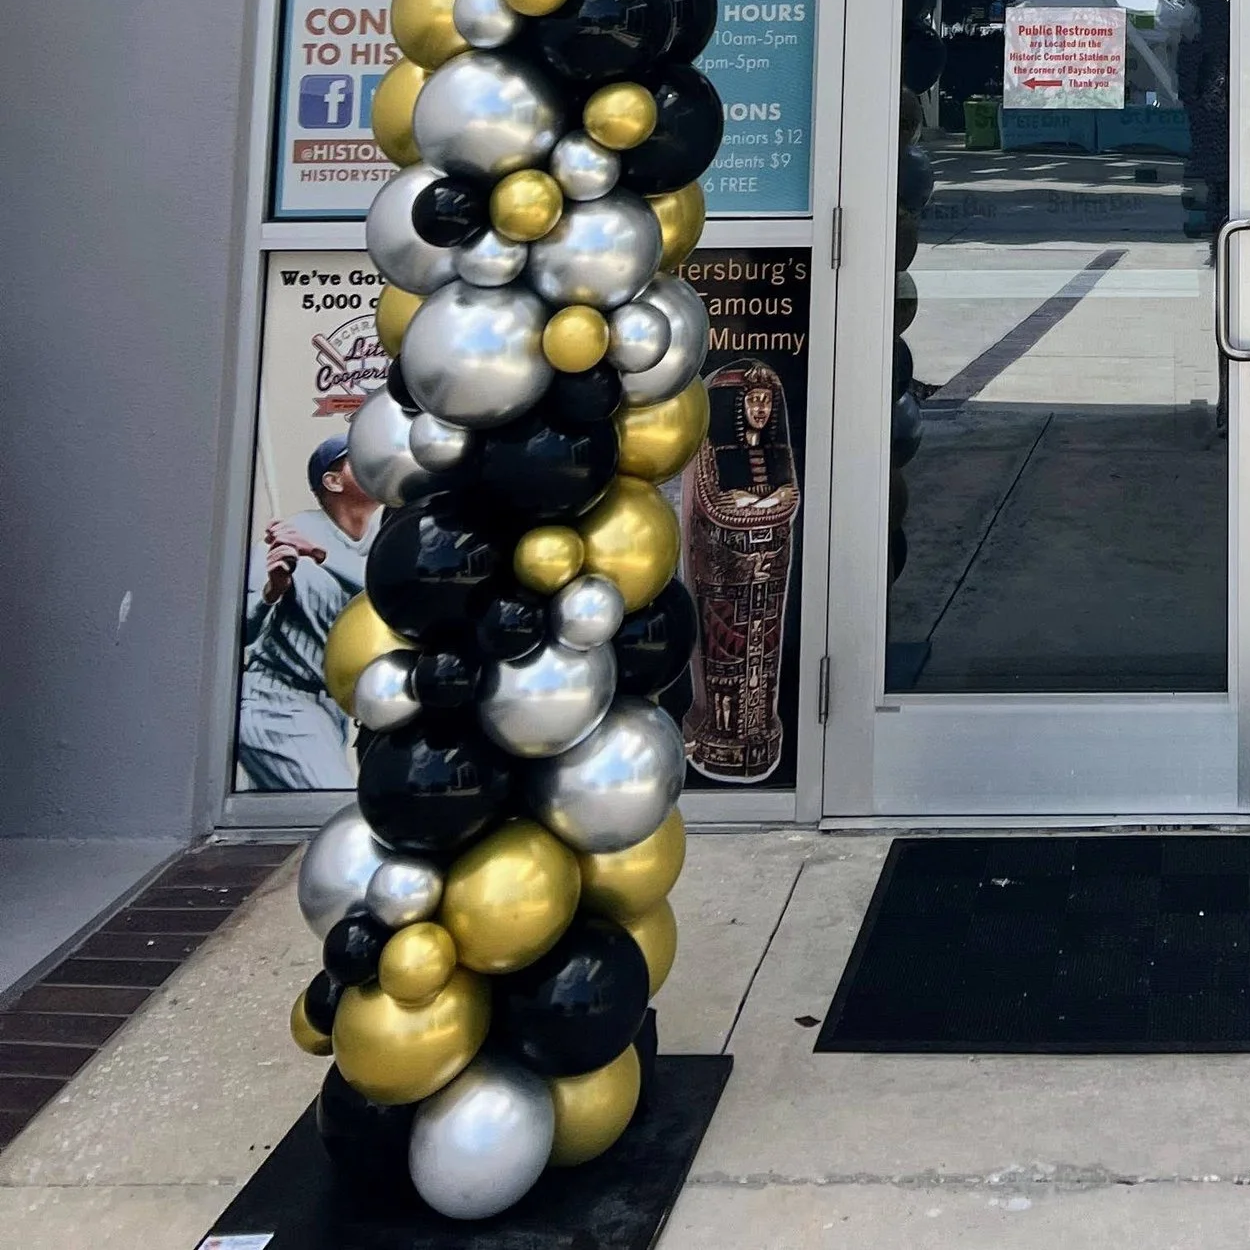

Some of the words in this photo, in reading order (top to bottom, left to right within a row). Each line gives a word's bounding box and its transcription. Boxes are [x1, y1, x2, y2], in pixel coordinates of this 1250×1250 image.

[724, 3, 806, 22] HOURS
[305, 8, 387, 36] CON
[1018, 25, 1053, 36] Public
[1056, 25, 1113, 36] Restrooms
[714, 30, 798, 48] 10am-5pm
[1045, 39, 1076, 48] Located
[1078, 39, 1086, 48] in
[1088, 39, 1102, 48] the
[303, 43, 341, 65] TO
[351, 43, 398, 65] HIS
[1010, 53, 1041, 61] Historic
[1044, 53, 1076, 61] Comfort
[1079, 53, 1108, 61] Station
[1014, 66, 1027, 74] the
[1058, 66, 1066, 74] of
[1068, 66, 1104, 76] Bayshore
[1069, 79, 1092, 88] Thank
[1094, 80, 1109, 89] you
[722, 103, 781, 121] IONS
[774, 129, 802, 146] $12
[770, 153, 792, 169] $9
[720, 177, 758, 192] FREE
[281, 270, 341, 285] We've
[349, 270, 386, 285] Got
[671, 258, 807, 285] tersburg's
[302, 293, 361, 312] 5,000
[697, 293, 793, 315] amous
[709, 328, 805, 355] Mummy
